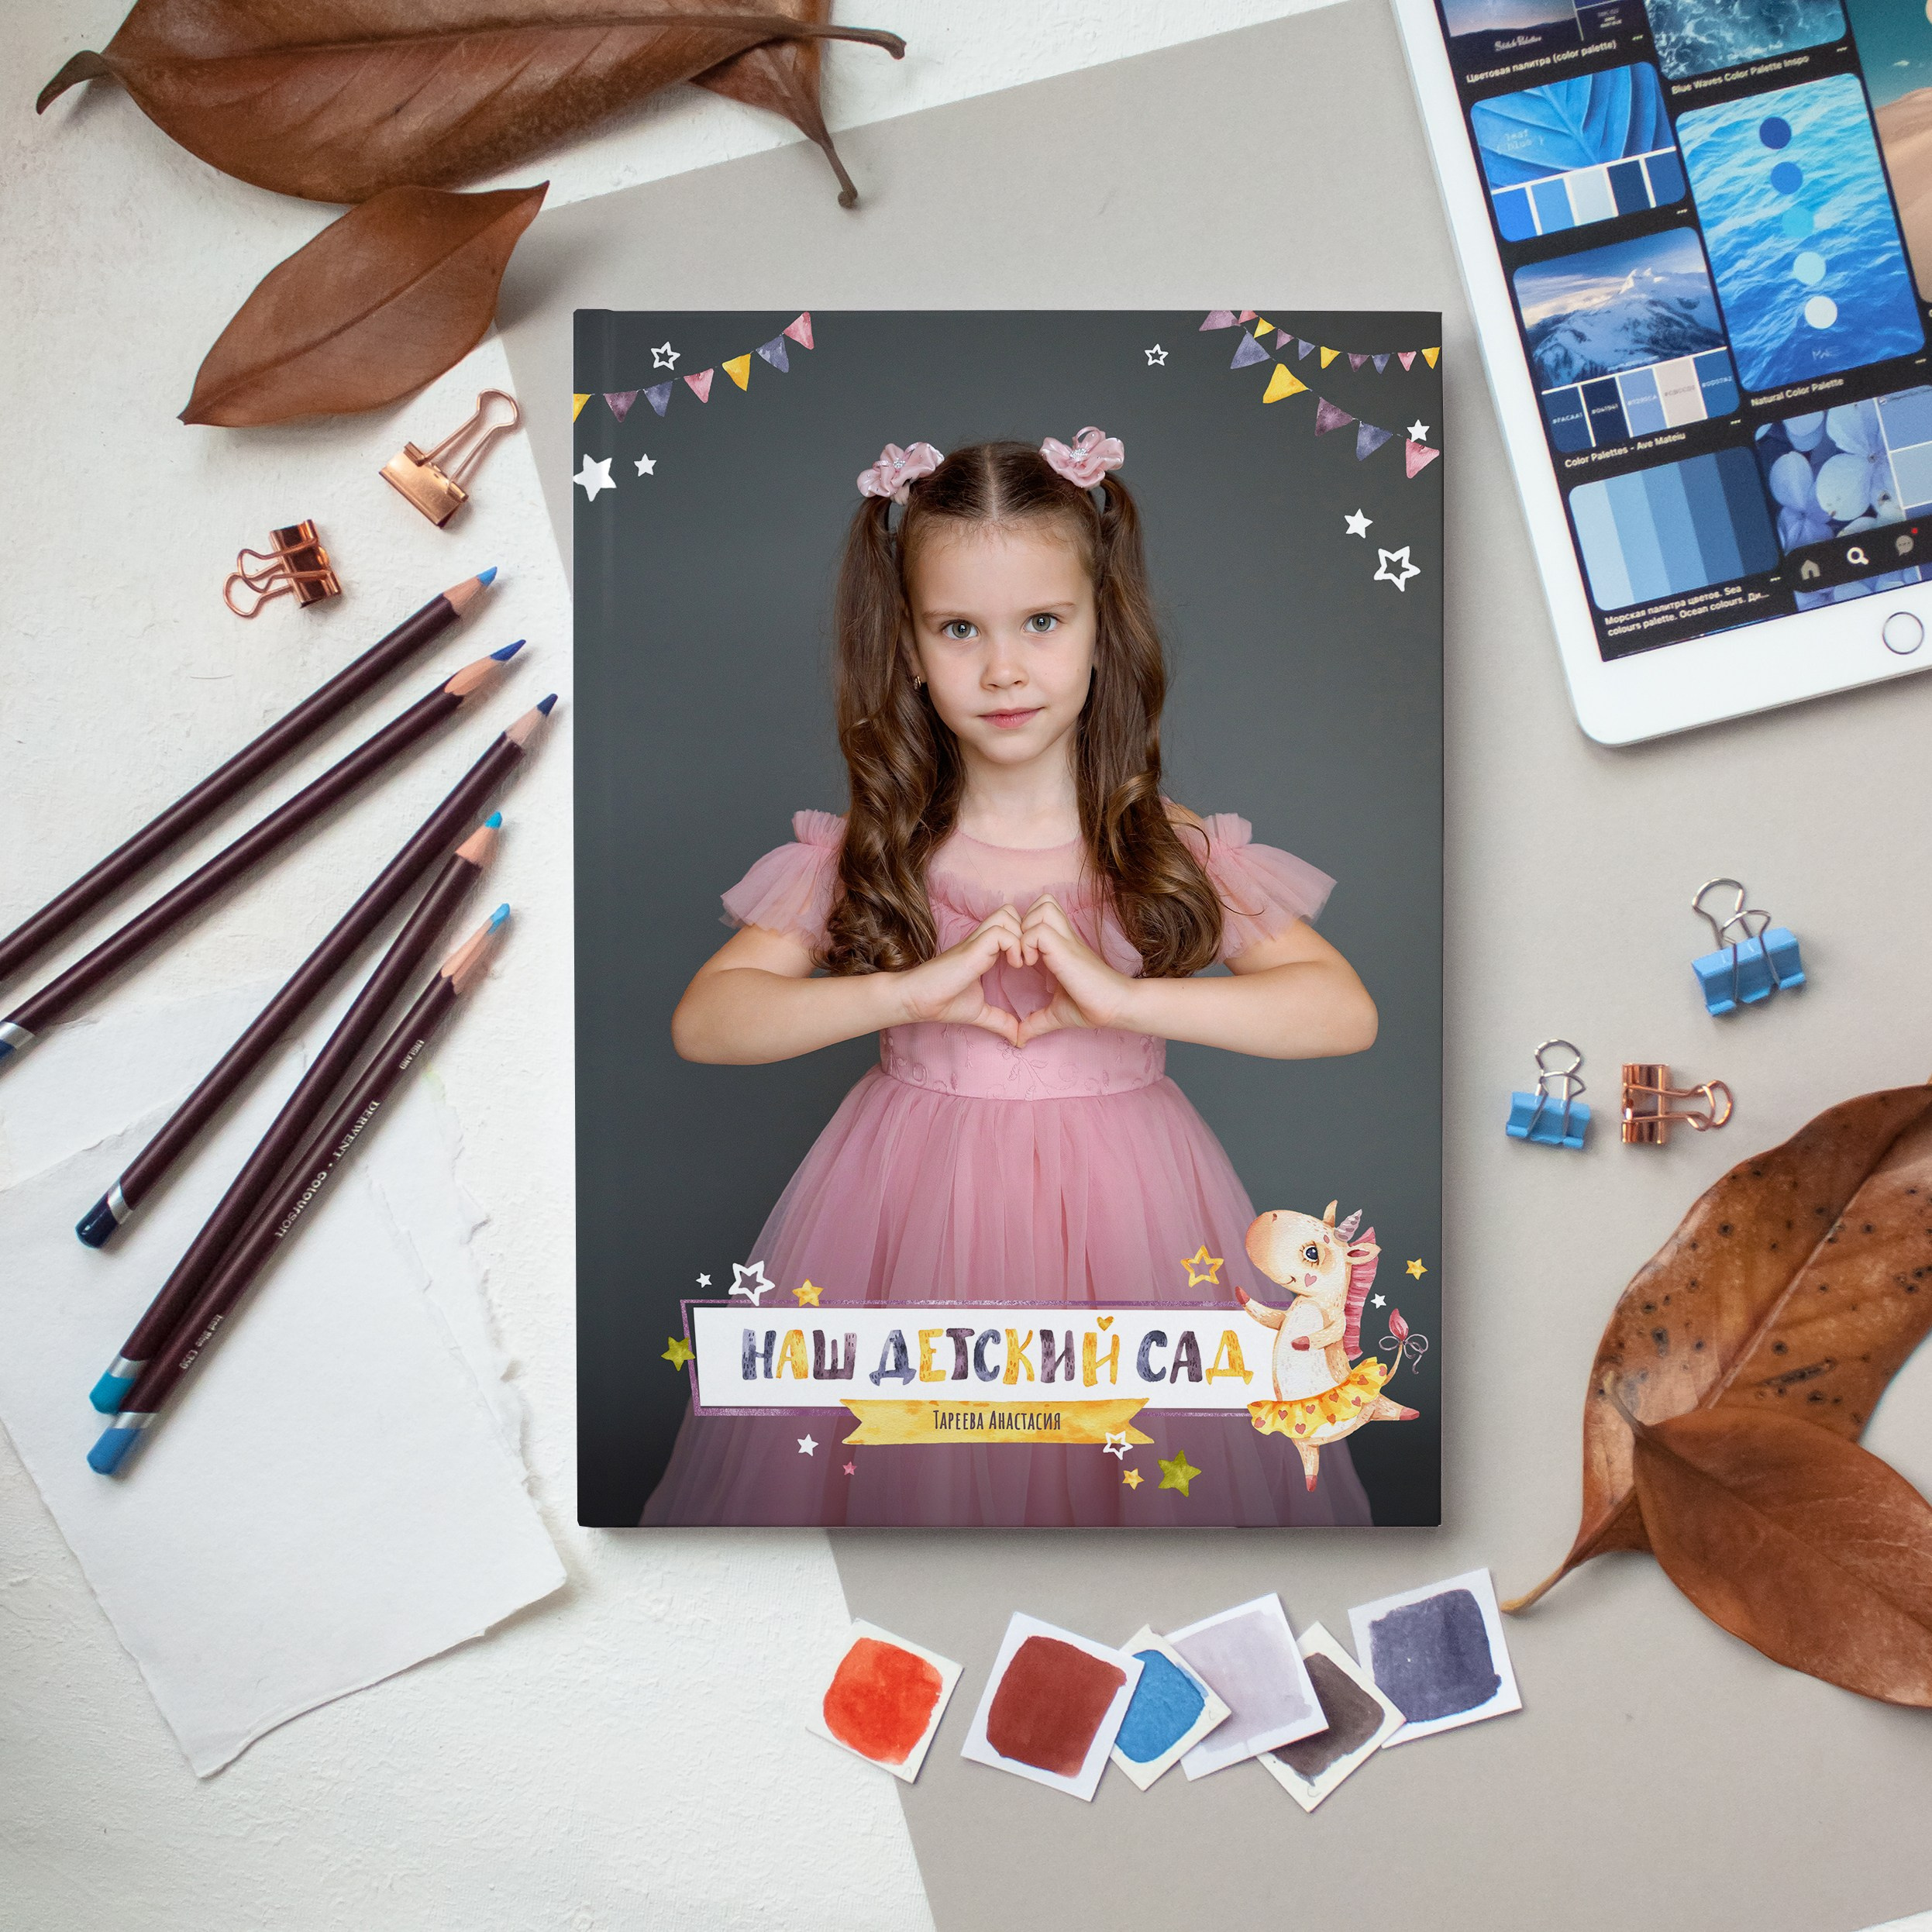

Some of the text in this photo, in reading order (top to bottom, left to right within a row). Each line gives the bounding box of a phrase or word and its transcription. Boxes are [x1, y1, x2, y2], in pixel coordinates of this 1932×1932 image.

[1466, 40, 1617, 83] Цветовая палитра (color palette)
[1672, 55, 1810, 95] Blue Waves Color Palette Inspo
[1751, 378, 1844, 406] Natural Color Palette
[1565, 456, 1589, 468] Color
[1591, 446, 1629, 462] Palettes
[1636, 439, 1653, 450] Ave
[1604, 585, 1742, 625] Морская палитра цветов. Sea
[1607, 624, 1641, 637] colours
[1643, 614, 1678, 630] palette.
[1679, 607, 1709, 619] Ocean
[1710, 598, 1746, 611] colours.
[399, 1039, 425, 1070] ENGLAND
[332, 1100, 381, 1159] DERWENT
[742, 1316, 1254, 1387] НАШ ДЕТСКИЙ САД
